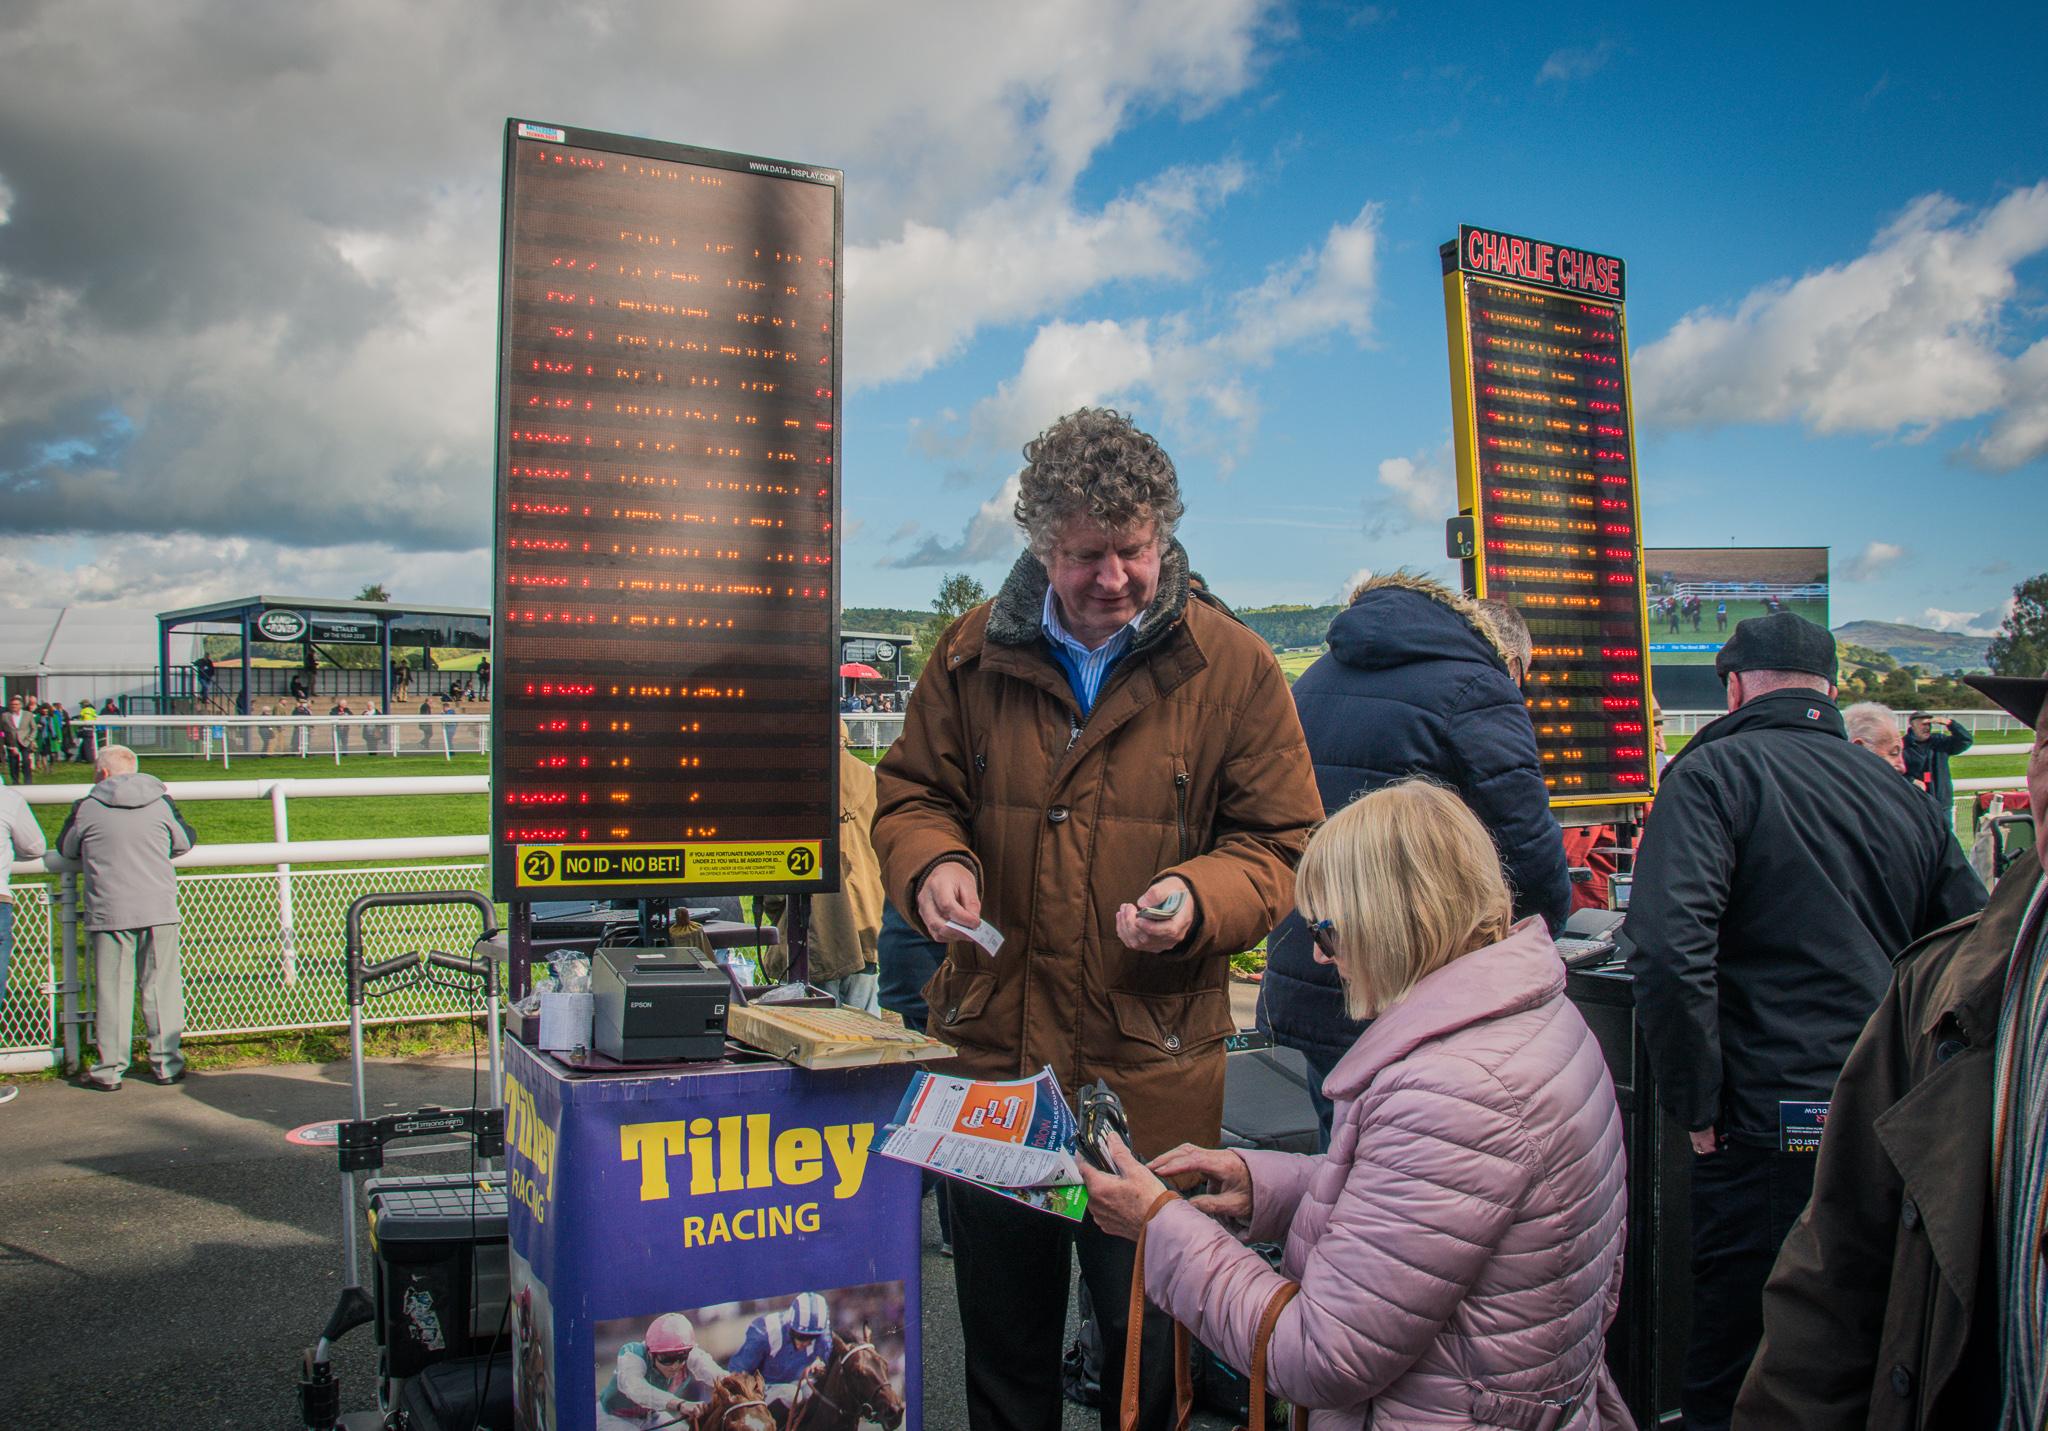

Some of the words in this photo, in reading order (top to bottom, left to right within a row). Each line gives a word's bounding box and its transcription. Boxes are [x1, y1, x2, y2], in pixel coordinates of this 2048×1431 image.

[1468, 230, 1554, 282] CHARLIE
[1557, 248, 1620, 295] CHASE
[267, 615, 292, 624] LAND
[269, 624, 298, 633] ROVER
[527, 857, 549, 876] 21
[566, 857, 591, 873] NO
[594, 857, 610, 873] ID
[621, 856, 645, 872] NO
[648, 855, 680, 872] BET!
[790, 853, 809, 871] 21
[504, 1071, 556, 1202] Tilley
[620, 1113, 875, 1201] Tilley
[683, 1202, 821, 1249] RACING
